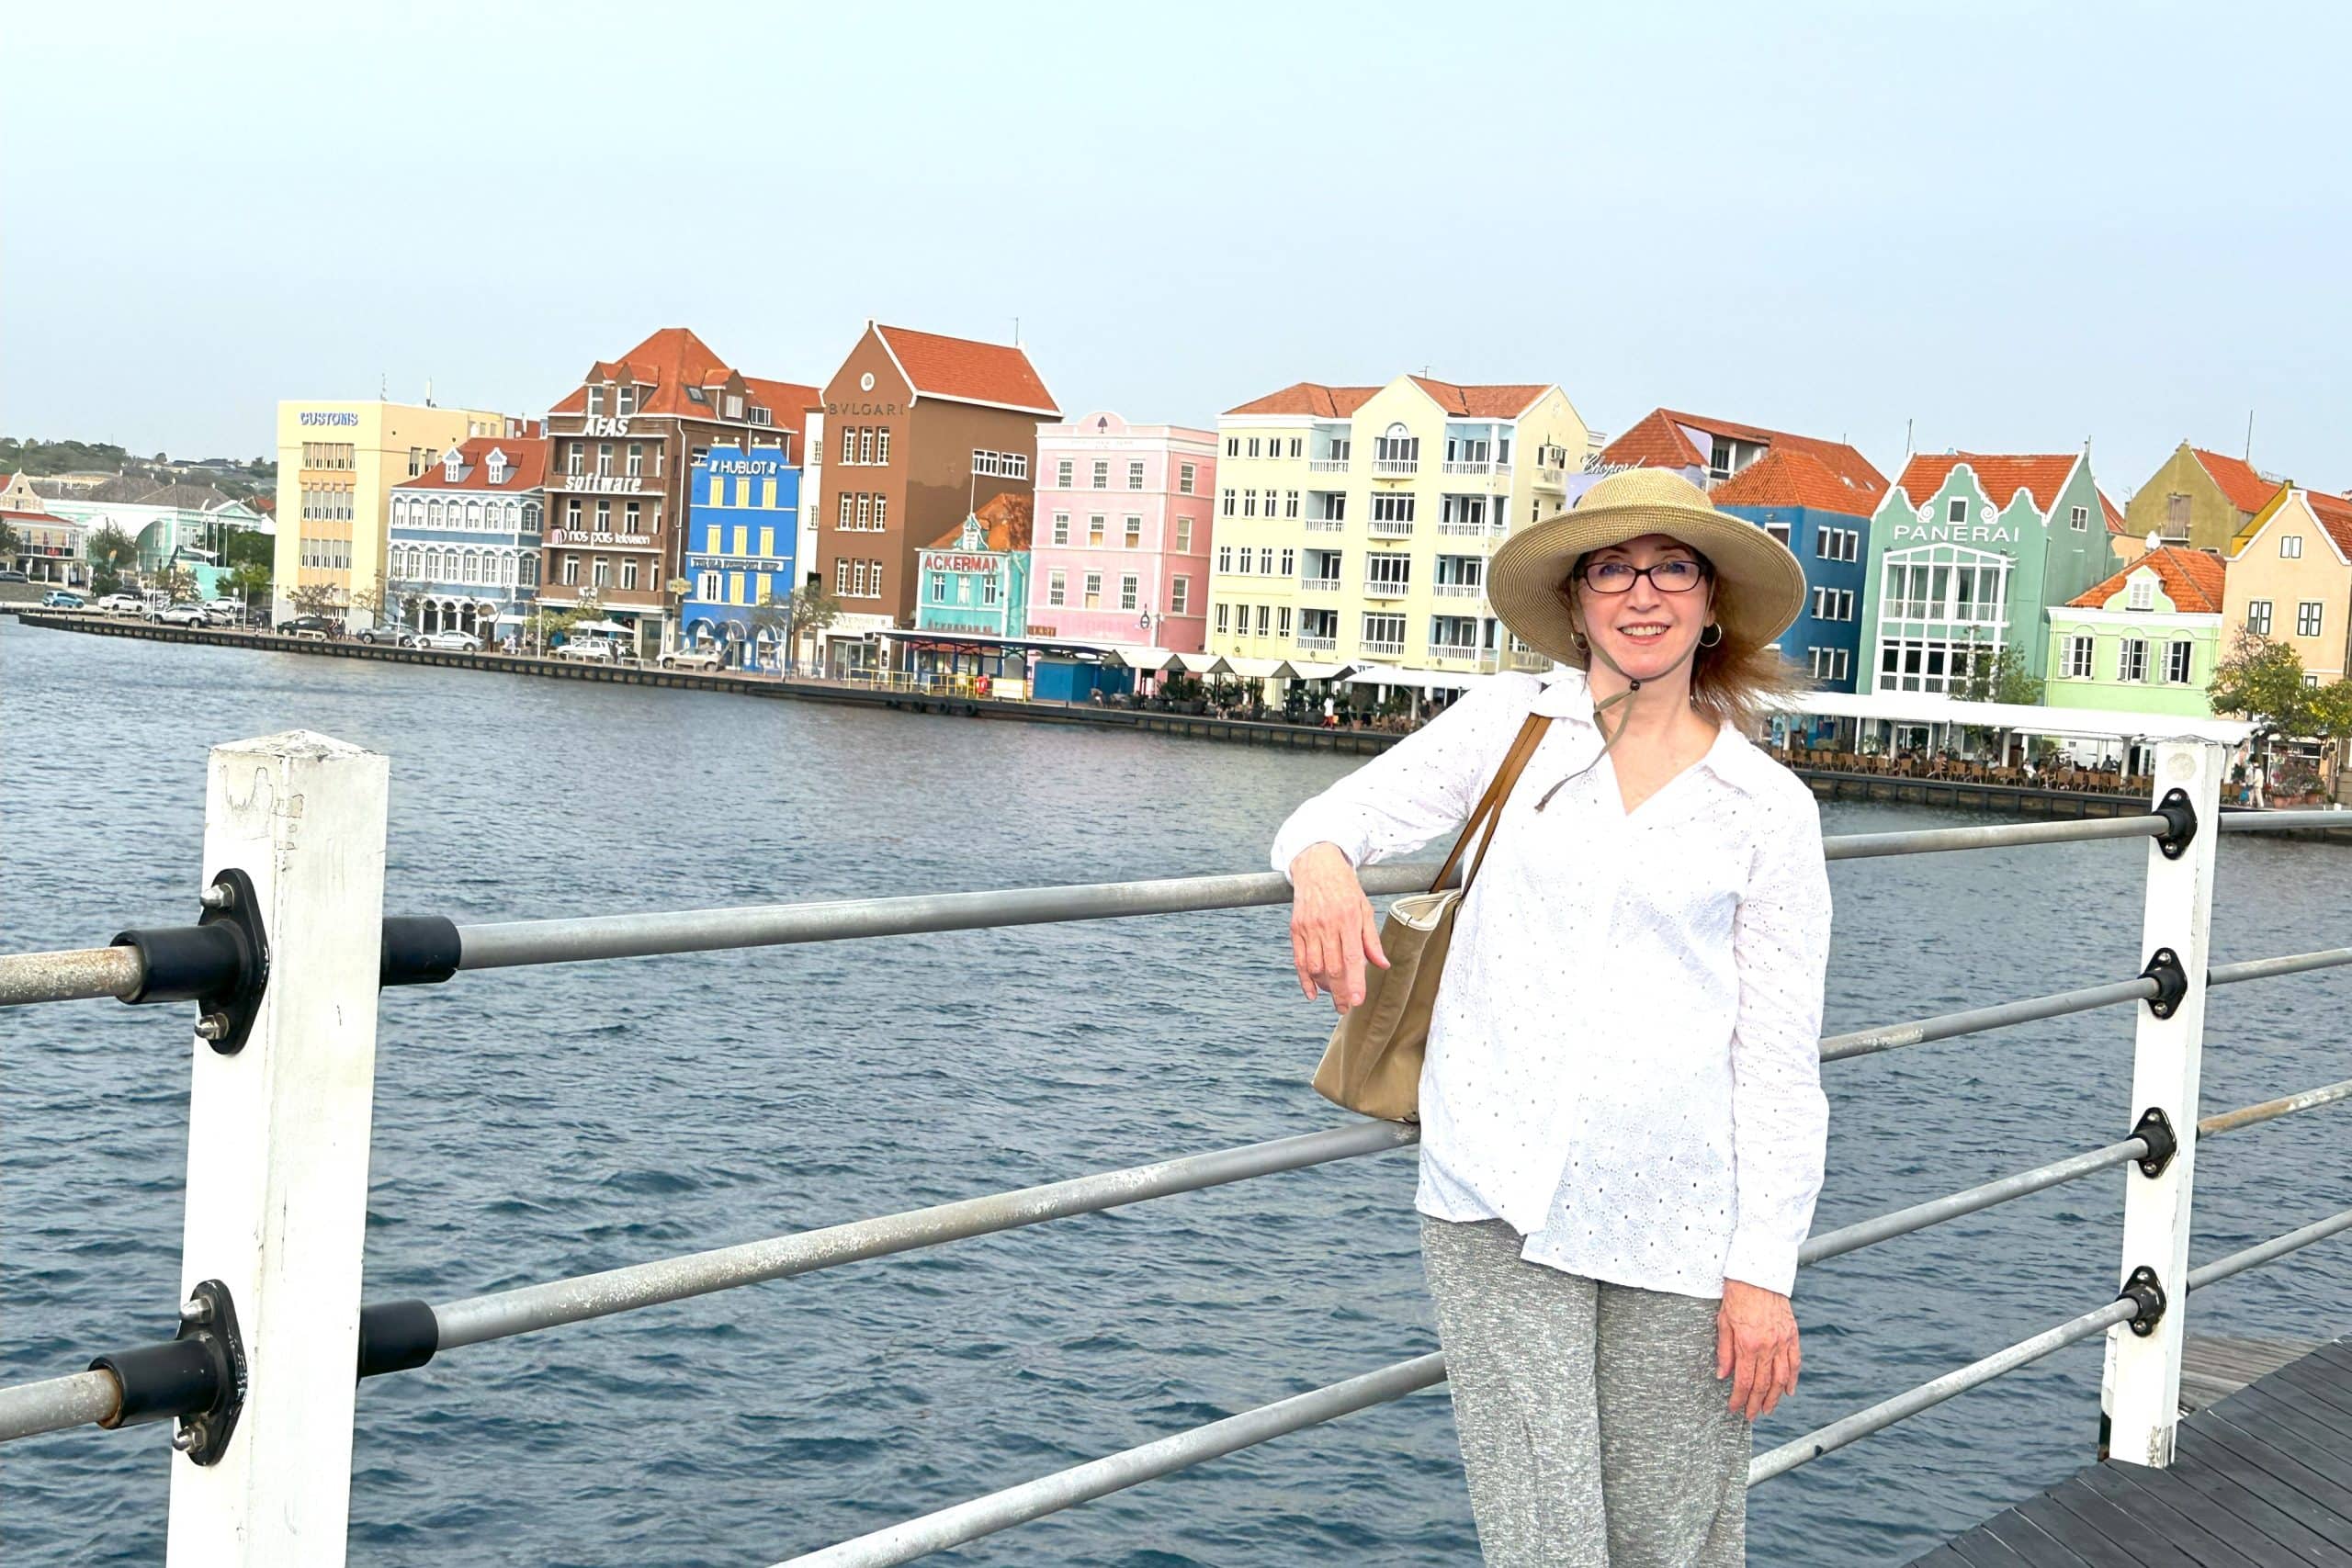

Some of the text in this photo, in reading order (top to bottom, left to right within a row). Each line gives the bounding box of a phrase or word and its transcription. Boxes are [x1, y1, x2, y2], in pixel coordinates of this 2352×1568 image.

[829, 402, 905, 416] BVLGARI
[300, 412, 359, 426] CUSTOMS
[582, 417, 629, 437] AFAS
[720, 459, 768, 475] HUBLOT
[565, 472, 642, 492] software
[569, 529, 588, 542] nos
[1893, 525, 2019, 543] PANERAI
